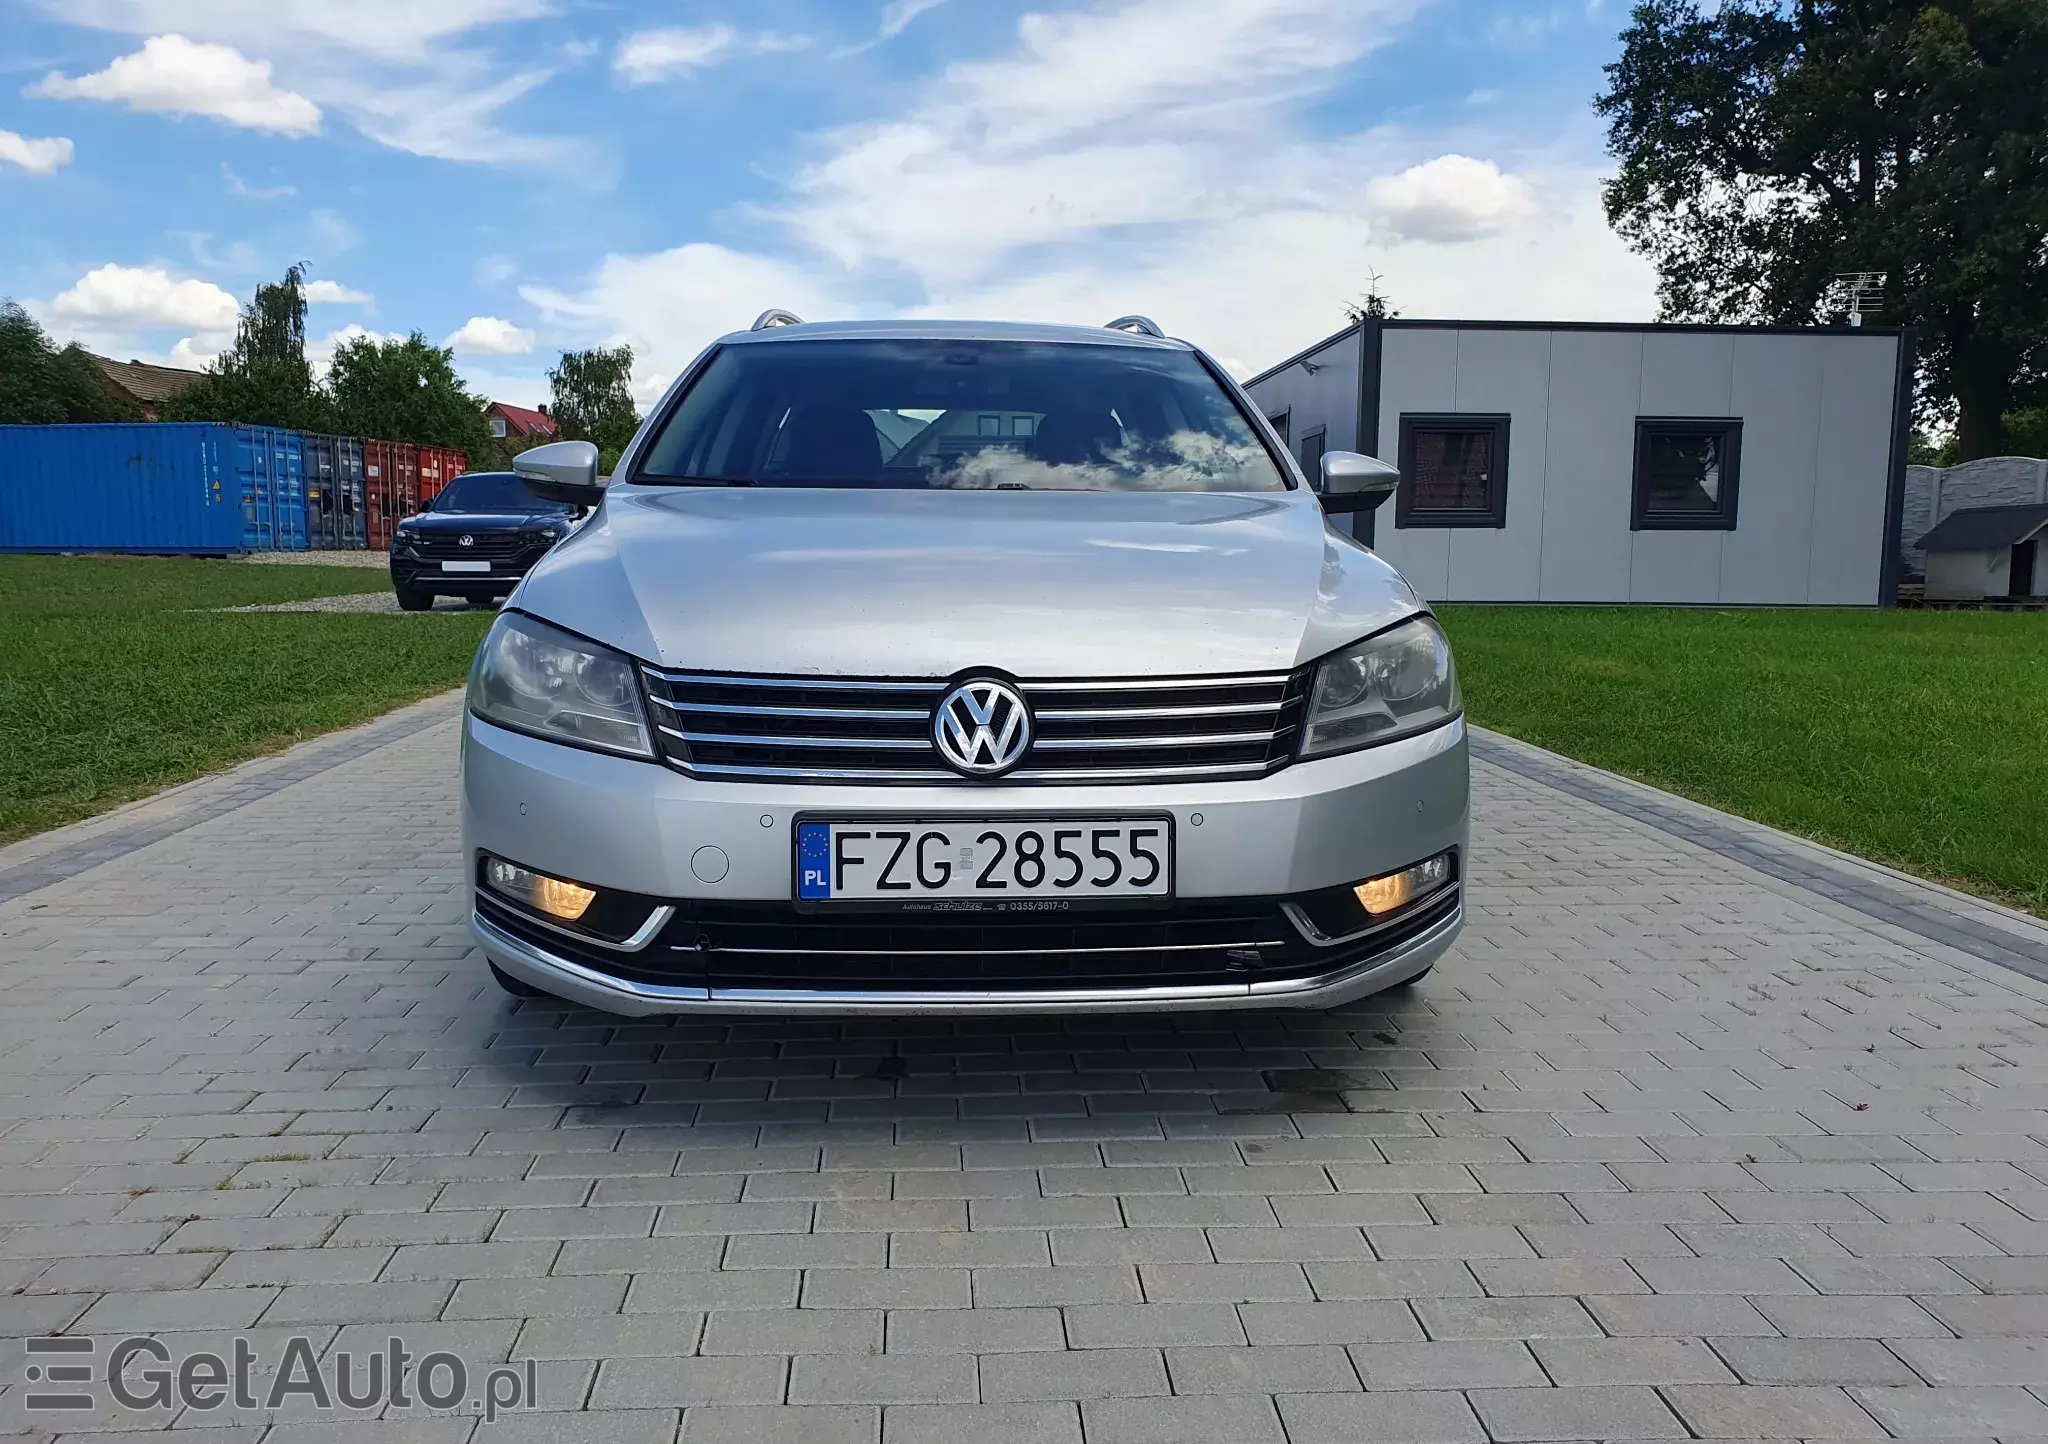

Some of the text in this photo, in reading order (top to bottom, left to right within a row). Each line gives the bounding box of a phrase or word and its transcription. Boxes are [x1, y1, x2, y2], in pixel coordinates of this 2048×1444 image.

[937, 683, 1027, 768] VW
[805, 870, 827, 886] PL
[835, 829, 1161, 891] FZG 28555
[1010, 901, 1069, 910] 0355/5817-0
